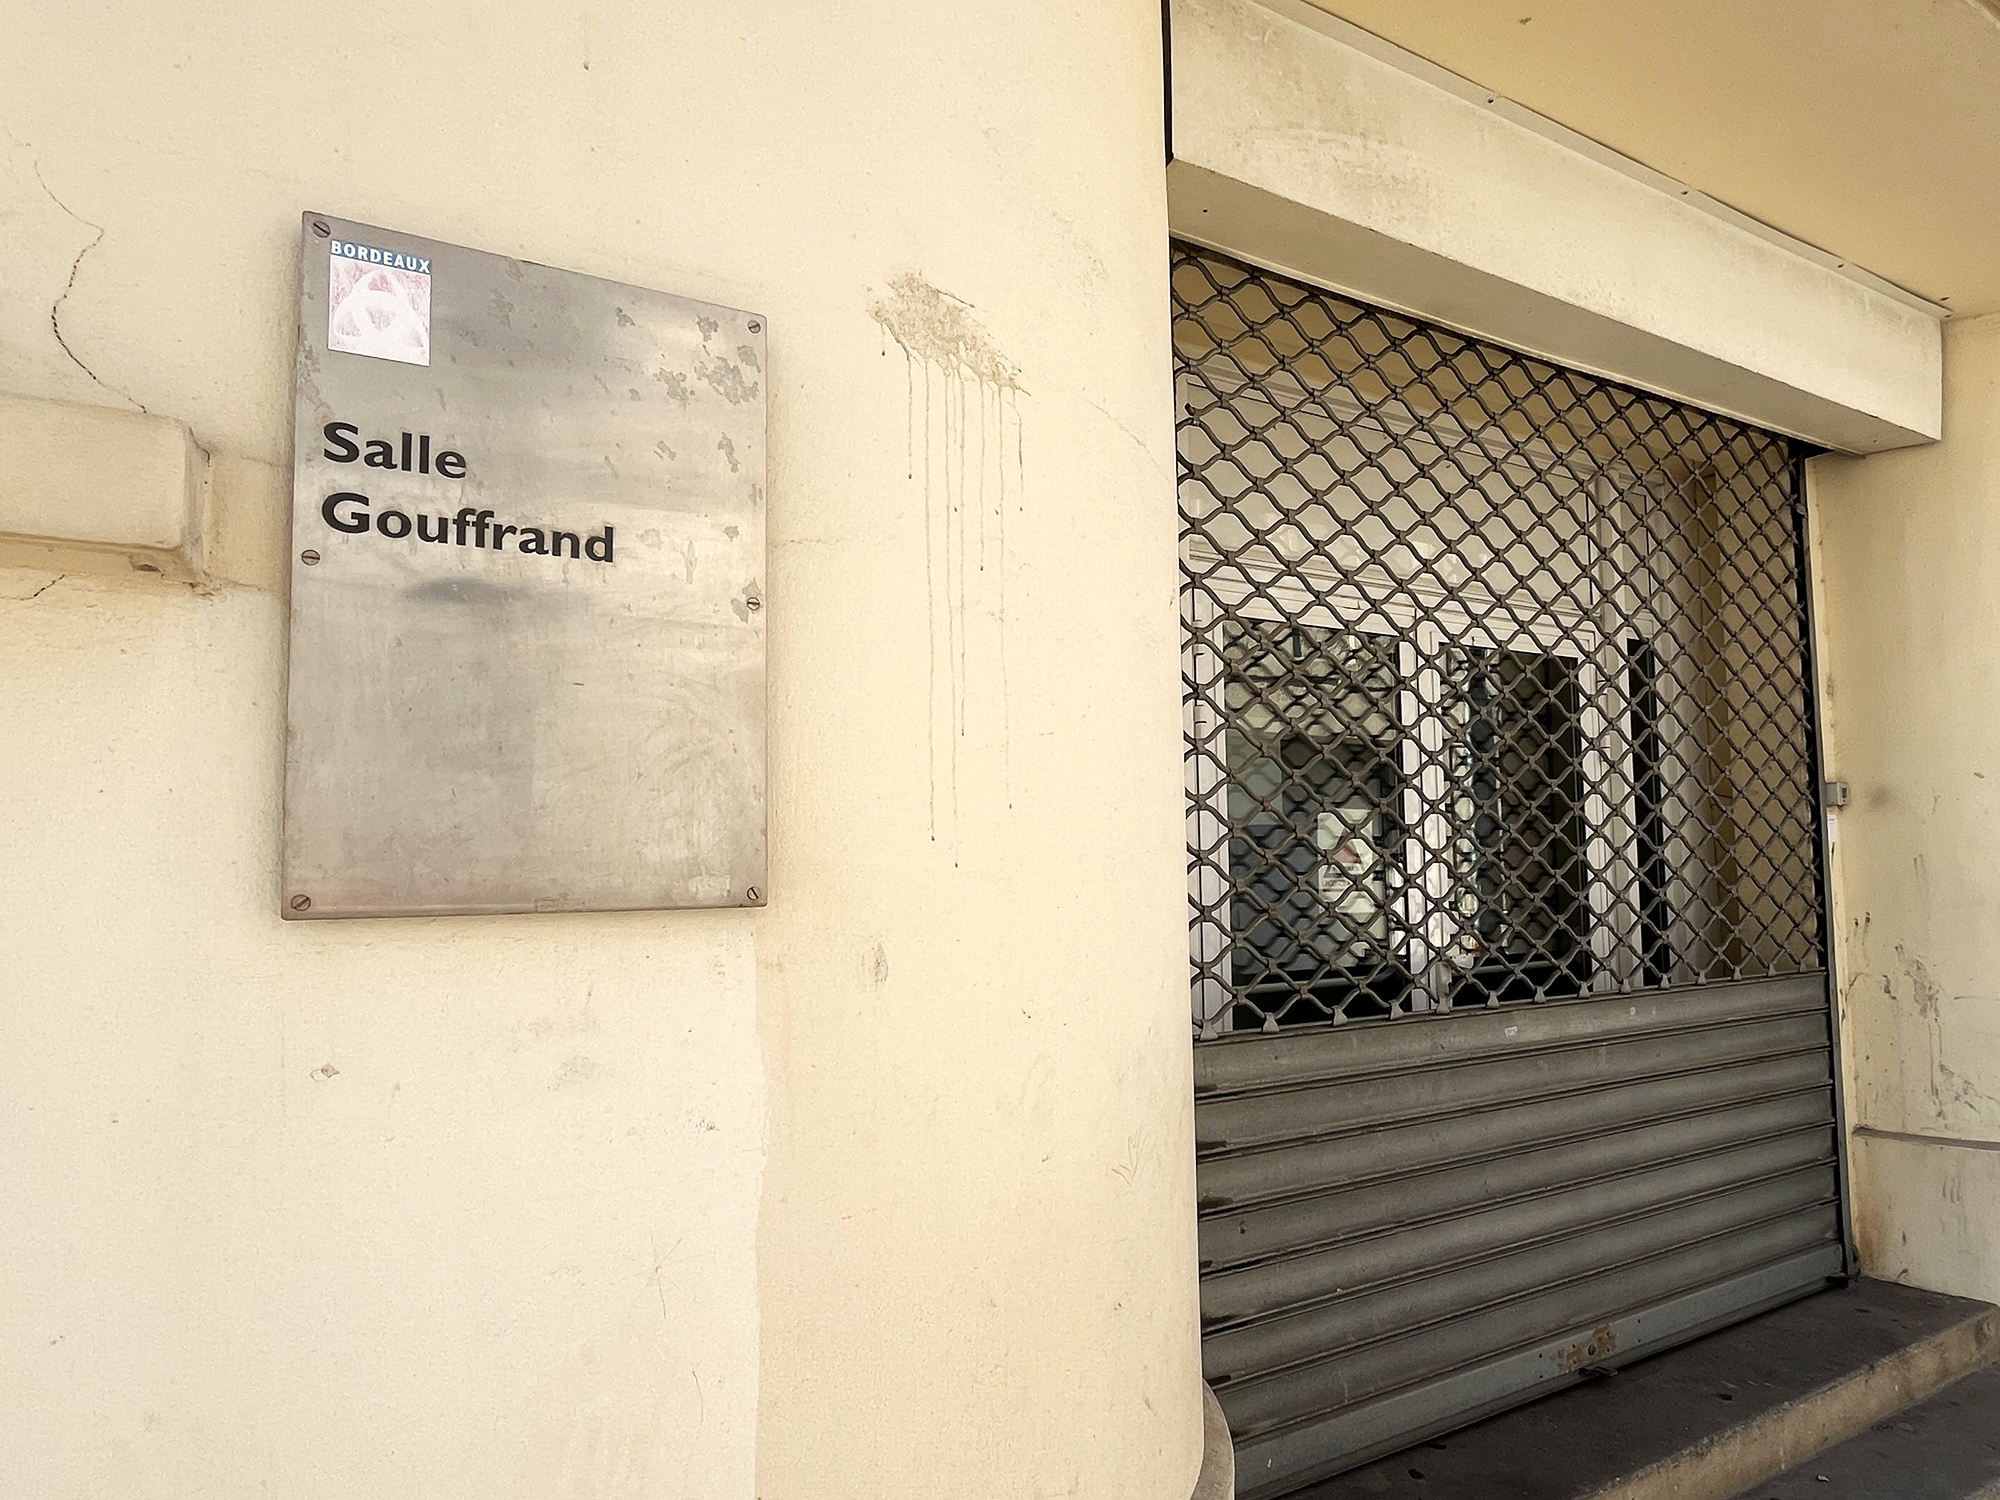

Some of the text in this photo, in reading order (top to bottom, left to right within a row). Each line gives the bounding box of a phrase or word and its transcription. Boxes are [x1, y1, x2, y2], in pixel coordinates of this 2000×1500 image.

[330, 240, 430, 274] BORDEAUX
[323, 422, 467, 479] Salle
[321, 492, 615, 563] Gouffrand
